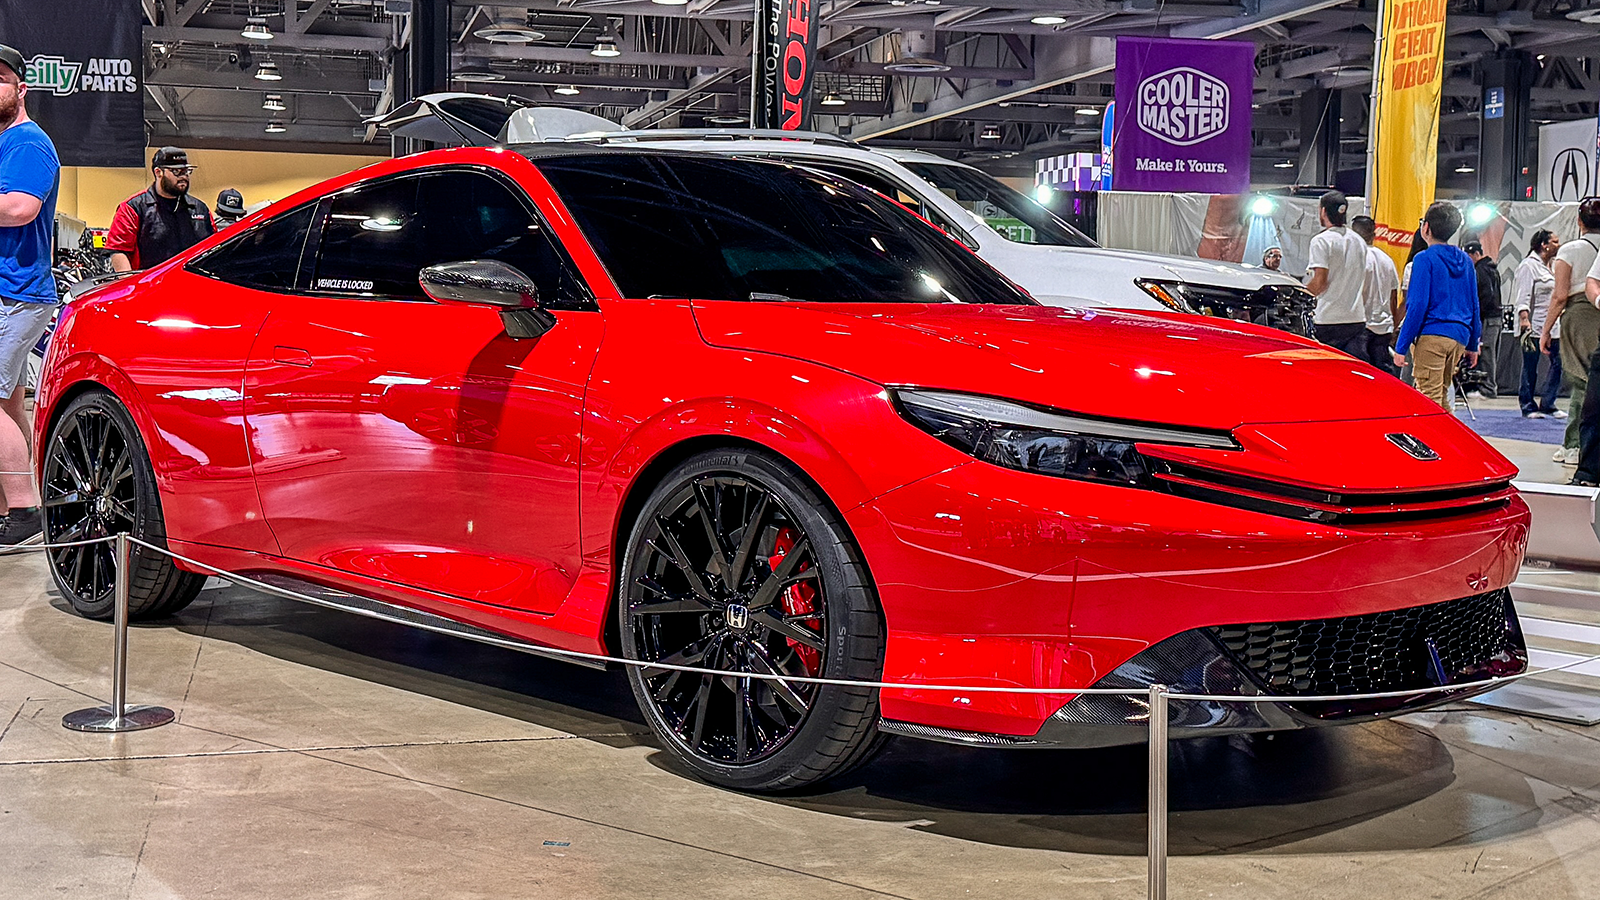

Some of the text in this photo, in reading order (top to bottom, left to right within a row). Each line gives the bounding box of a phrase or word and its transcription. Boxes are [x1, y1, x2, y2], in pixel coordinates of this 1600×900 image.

[25, 60, 74, 90] eilly
[87, 58, 132, 76] AUTO
[781, 0, 809, 142] HON
[81, 75, 138, 93] PARTS
[1143, 72, 1226, 108] COOLER
[1142, 104, 1225, 140] MASTER
[1136, 157, 1228, 174] Make It Yours.
[317, 278, 374, 290] VEHICLE IS LOCKED
